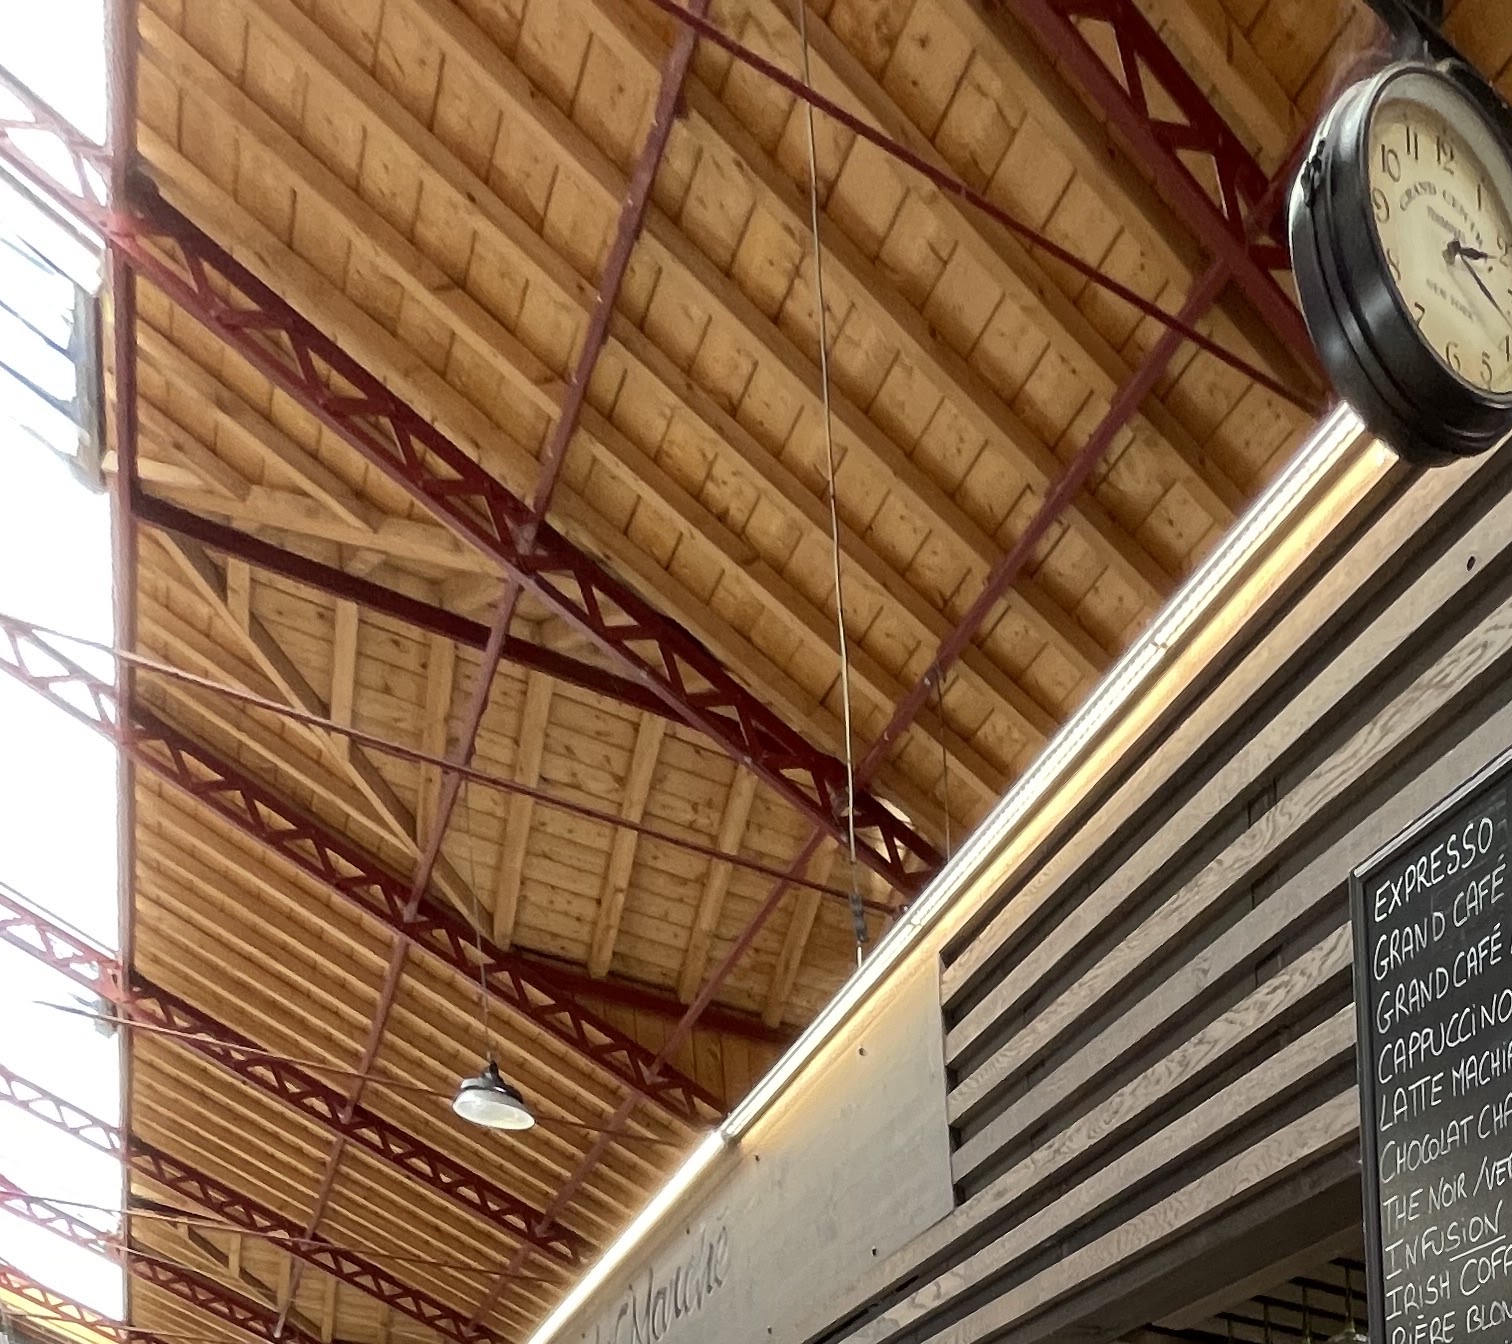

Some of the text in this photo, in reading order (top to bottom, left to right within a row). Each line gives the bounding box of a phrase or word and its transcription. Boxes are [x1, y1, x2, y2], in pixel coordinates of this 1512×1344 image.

[1373, 912, 1445, 981] GRAND
[1453, 854, 1507, 928] CAFÉ
[1374, 818, 1493, 922] EXPRESSO
[1376, 967, 1449, 1035] GRAND
[1453, 923, 1502, 988] CAFÉ
[1380, 1072, 1445, 1132] LATTE
[1382, 1188, 1424, 1234] THE
